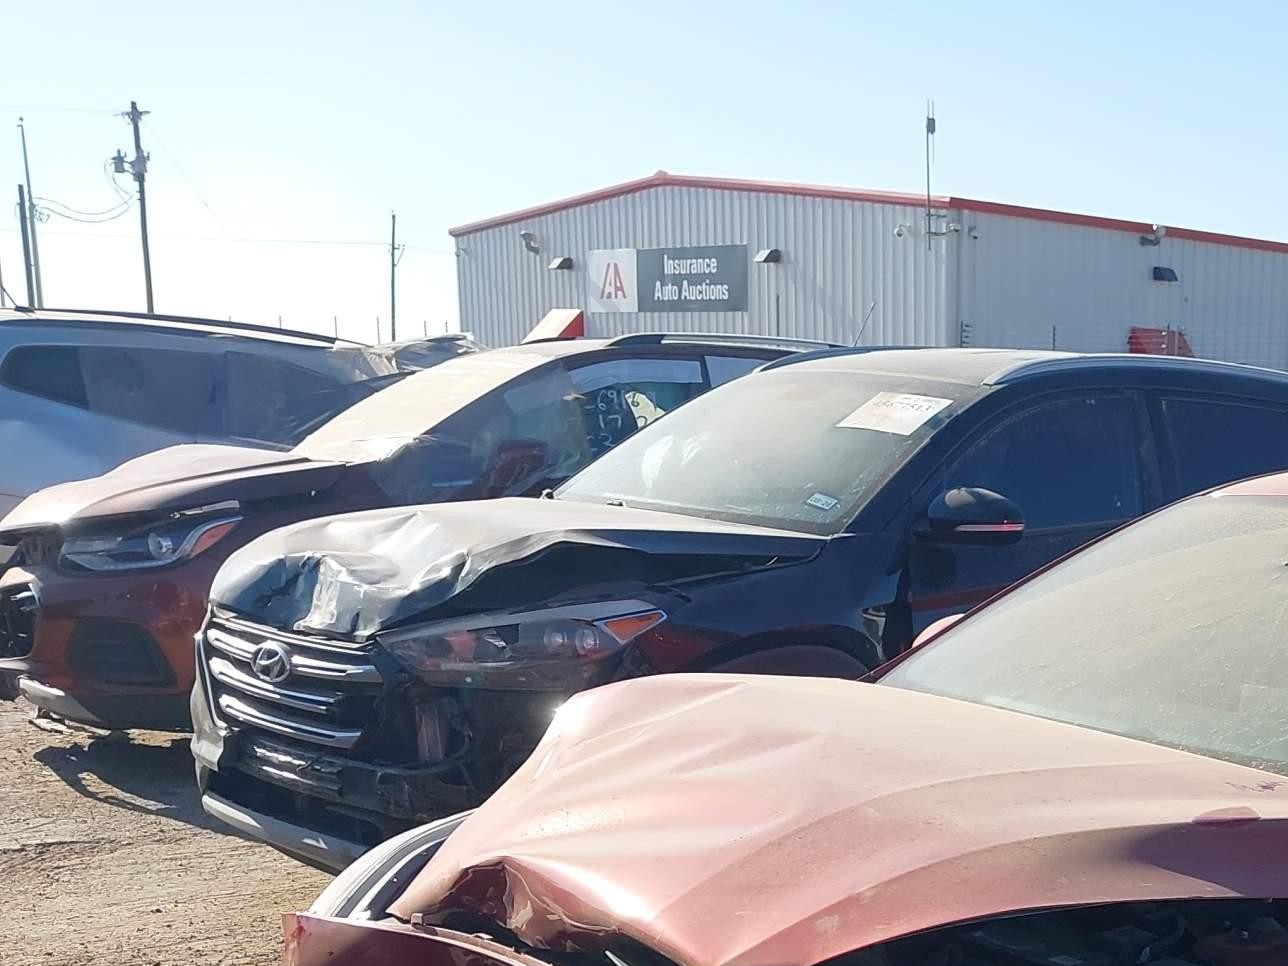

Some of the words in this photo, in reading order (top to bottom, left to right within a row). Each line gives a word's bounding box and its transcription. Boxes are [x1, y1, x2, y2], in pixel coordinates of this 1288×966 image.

[663, 254, 718, 275] Insurance
[654, 280, 679, 301] Auto
[681, 279, 729, 301] Auctions
